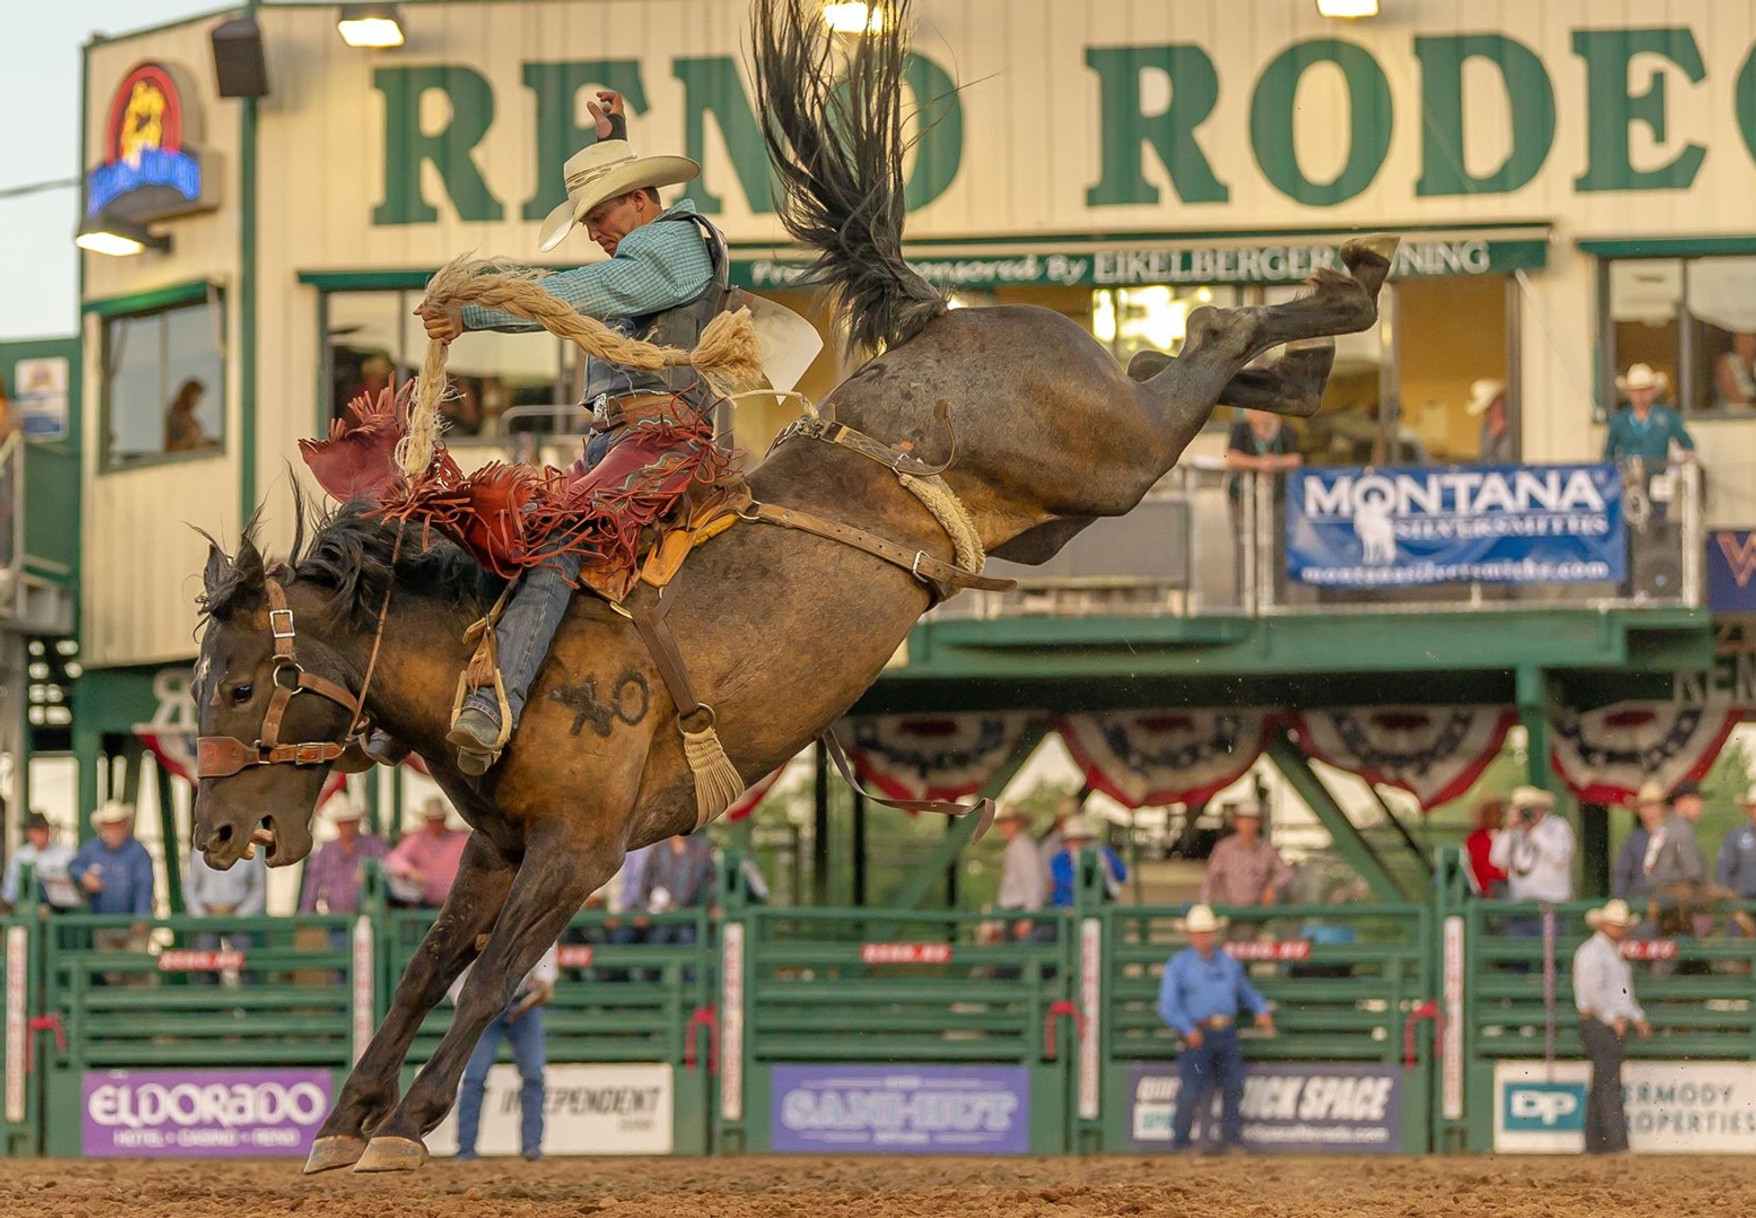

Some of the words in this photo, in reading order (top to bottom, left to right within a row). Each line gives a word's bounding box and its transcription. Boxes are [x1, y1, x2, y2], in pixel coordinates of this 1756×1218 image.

[373, 53, 962, 225] RENO
[1085, 26, 1756, 207] RODE
[1046, 252, 1086, 285] By
[1303, 470, 1606, 518] MONTANA
[500, 1085, 662, 1115] INEPENDENT
[1299, 1076, 1392, 1120] SPACE
[1619, 1083, 1734, 1106] ERMODY
